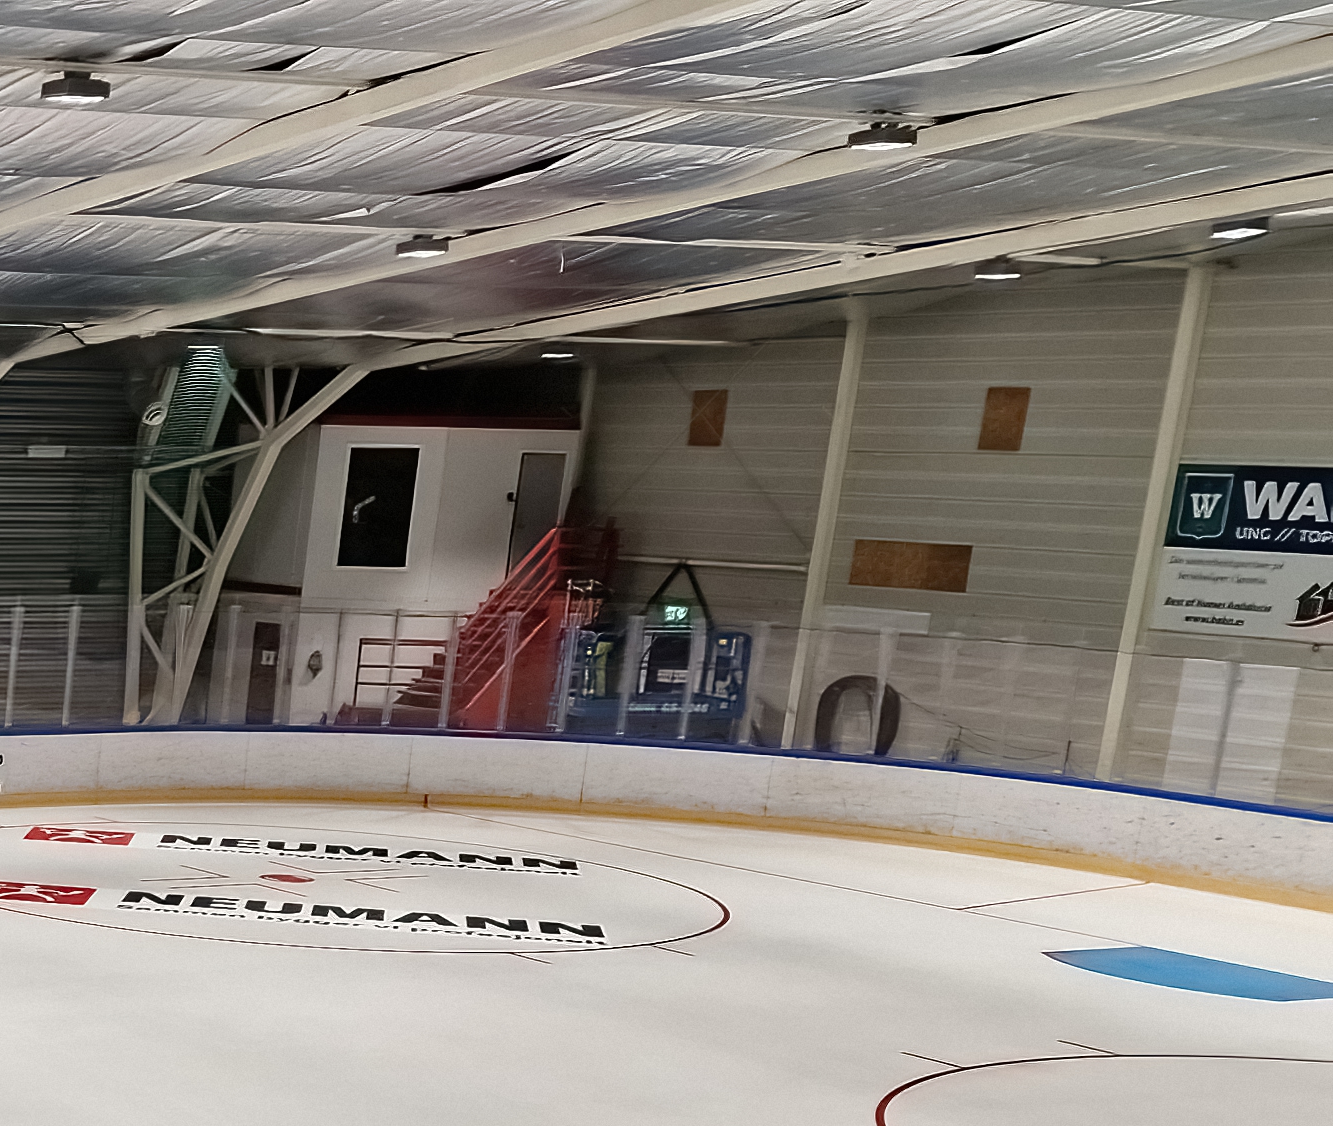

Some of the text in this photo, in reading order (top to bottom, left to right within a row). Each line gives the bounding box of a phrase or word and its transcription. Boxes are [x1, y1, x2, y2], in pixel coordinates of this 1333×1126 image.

[1190, 494, 1223, 518] W
[1244, 480, 1333, 523] WA
[1235, 526, 1272, 541] UNG
[160, 834, 578, 870] NEUMANN
[120, 891, 606, 938] NEUMANN
